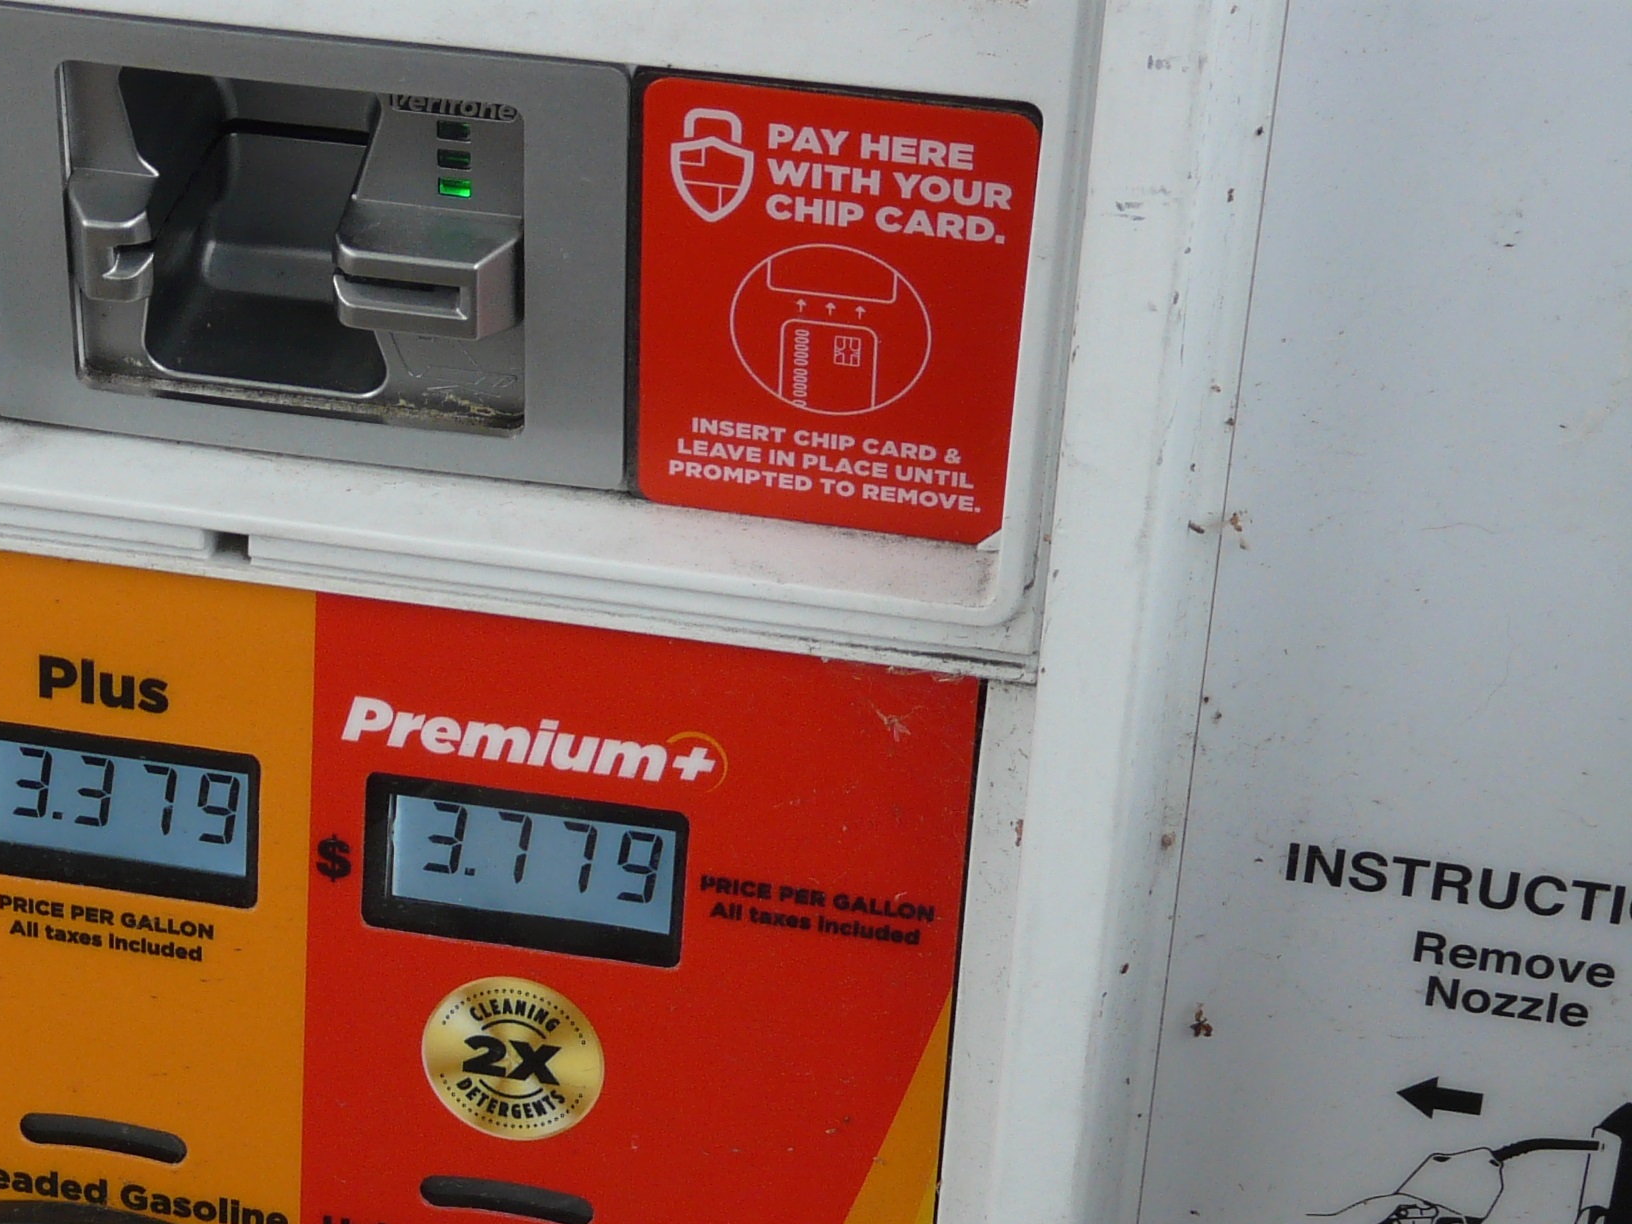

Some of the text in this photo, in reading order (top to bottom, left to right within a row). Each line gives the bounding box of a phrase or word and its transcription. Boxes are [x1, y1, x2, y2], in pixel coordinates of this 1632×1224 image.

[768, 123, 974, 170] PAY HERE
[767, 158, 1013, 210] WITH YOUR
[767, 193, 1005, 244] CHIP CARD.
[678, 438, 974, 490] LEAVE IN PLACE UNTIL
[692, 417, 961, 465] INSERT CHIP CARD &
[669, 459, 981, 513] PROMPTED TO REMOVE.
[38, 654, 169, 714] Plus
[13, 746, 240, 845] 3.379
[316, 802, 663, 904] $ 3.779
[700, 874, 936, 923] PRICE PER GALLON
[1285, 842, 1632, 925] INSTRUCTI
[9, 919, 203, 962] All taxes included
[70, 904, 115, 926] PER
[120, 912, 214, 940] GALLON
[709, 900, 921, 947] All taxes included
[1413, 930, 1616, 989] Remove
[470, 998, 561, 1033] CLEANING
[1424, 975, 1589, 1028] Nozzle
[462, 1035, 562, 1086] 2X
[456, 1077, 566, 1120] DETERGENTS
